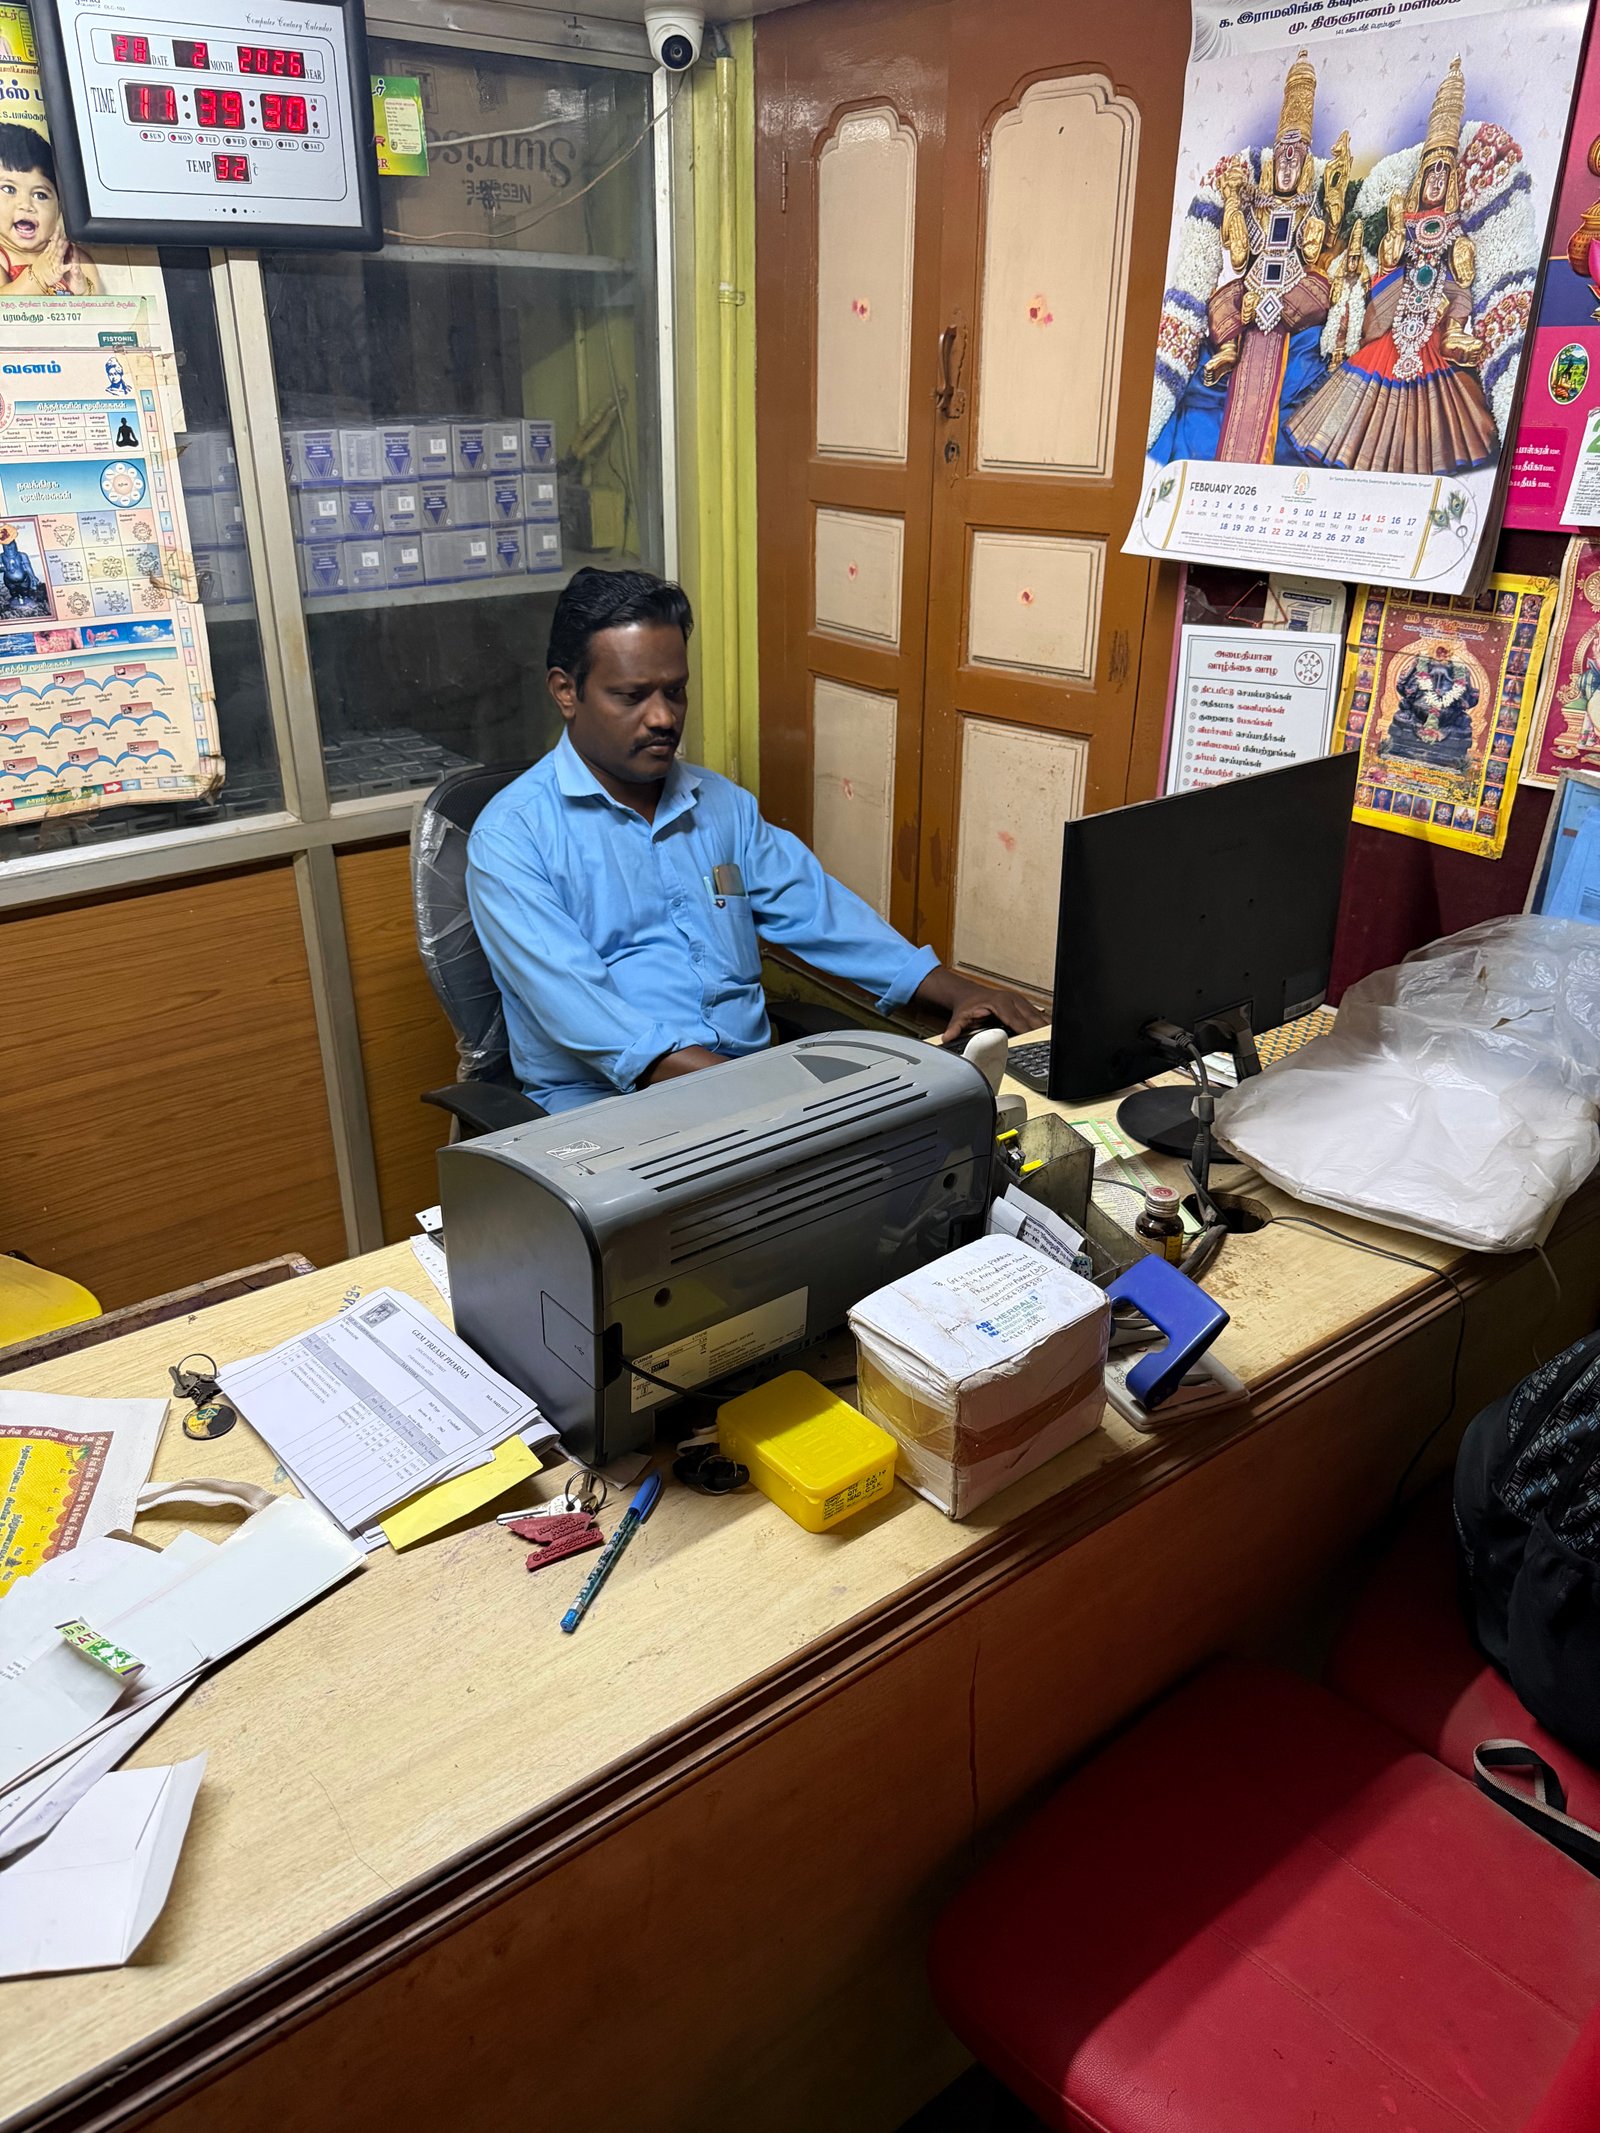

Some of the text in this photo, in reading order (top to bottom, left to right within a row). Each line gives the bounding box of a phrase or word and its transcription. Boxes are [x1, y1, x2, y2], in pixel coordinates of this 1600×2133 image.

[245, 13, 333, 32] Computer Century Calendar
[1310, 3, 1396, 31] திருஞானம்
[115, 35, 322, 80] 28 DATE 2 MONTH 2026 YEAR
[90, 87, 305, 131] TIME 11 39 30
[186, 160, 212, 173] TEMP
[217, 156, 246, 180] 32
[3, 312, 44, 323] பரமக்குடி
[2, 360, 62, 374] வனம்
[1190, 482, 1257, 496] FEBRUARY 2026
[1253, 504, 1258, 512] 6
[1266, 505, 1272, 513] 7
[1279, 506, 1285, 514] 8
[1319, 510, 1327, 518] 11
[1361, 514, 1371, 522] 14
[1376, 515, 1386, 523] 15
[1391, 516, 1401, 524] 16
[1407, 518, 1417, 526] 17
[1220, 522, 1228, 530] 18
[1258, 526, 1267, 534] 21
[1271, 527, 1281, 535] 22
[1285, 529, 1294, 537] 23
[1298, 530, 1308, 538] 24
[1312, 532, 1322, 540] 25
[1326, 533, 1336, 541] 26
[1340, 534, 1350, 542] 27
[1355, 536, 1365, 544] 28
[1215, 650, 1272, 661] அமைதியான
[1207, 661, 1278, 676] வாழ்க்கை வாழ
[1200, 685, 1234, 696] திட்டமிட்டு
[994, 1295, 1038, 1322] HERBALS
[412, 1329, 424, 1342] GEM
[443, 1354, 470, 1380] PHARMA
